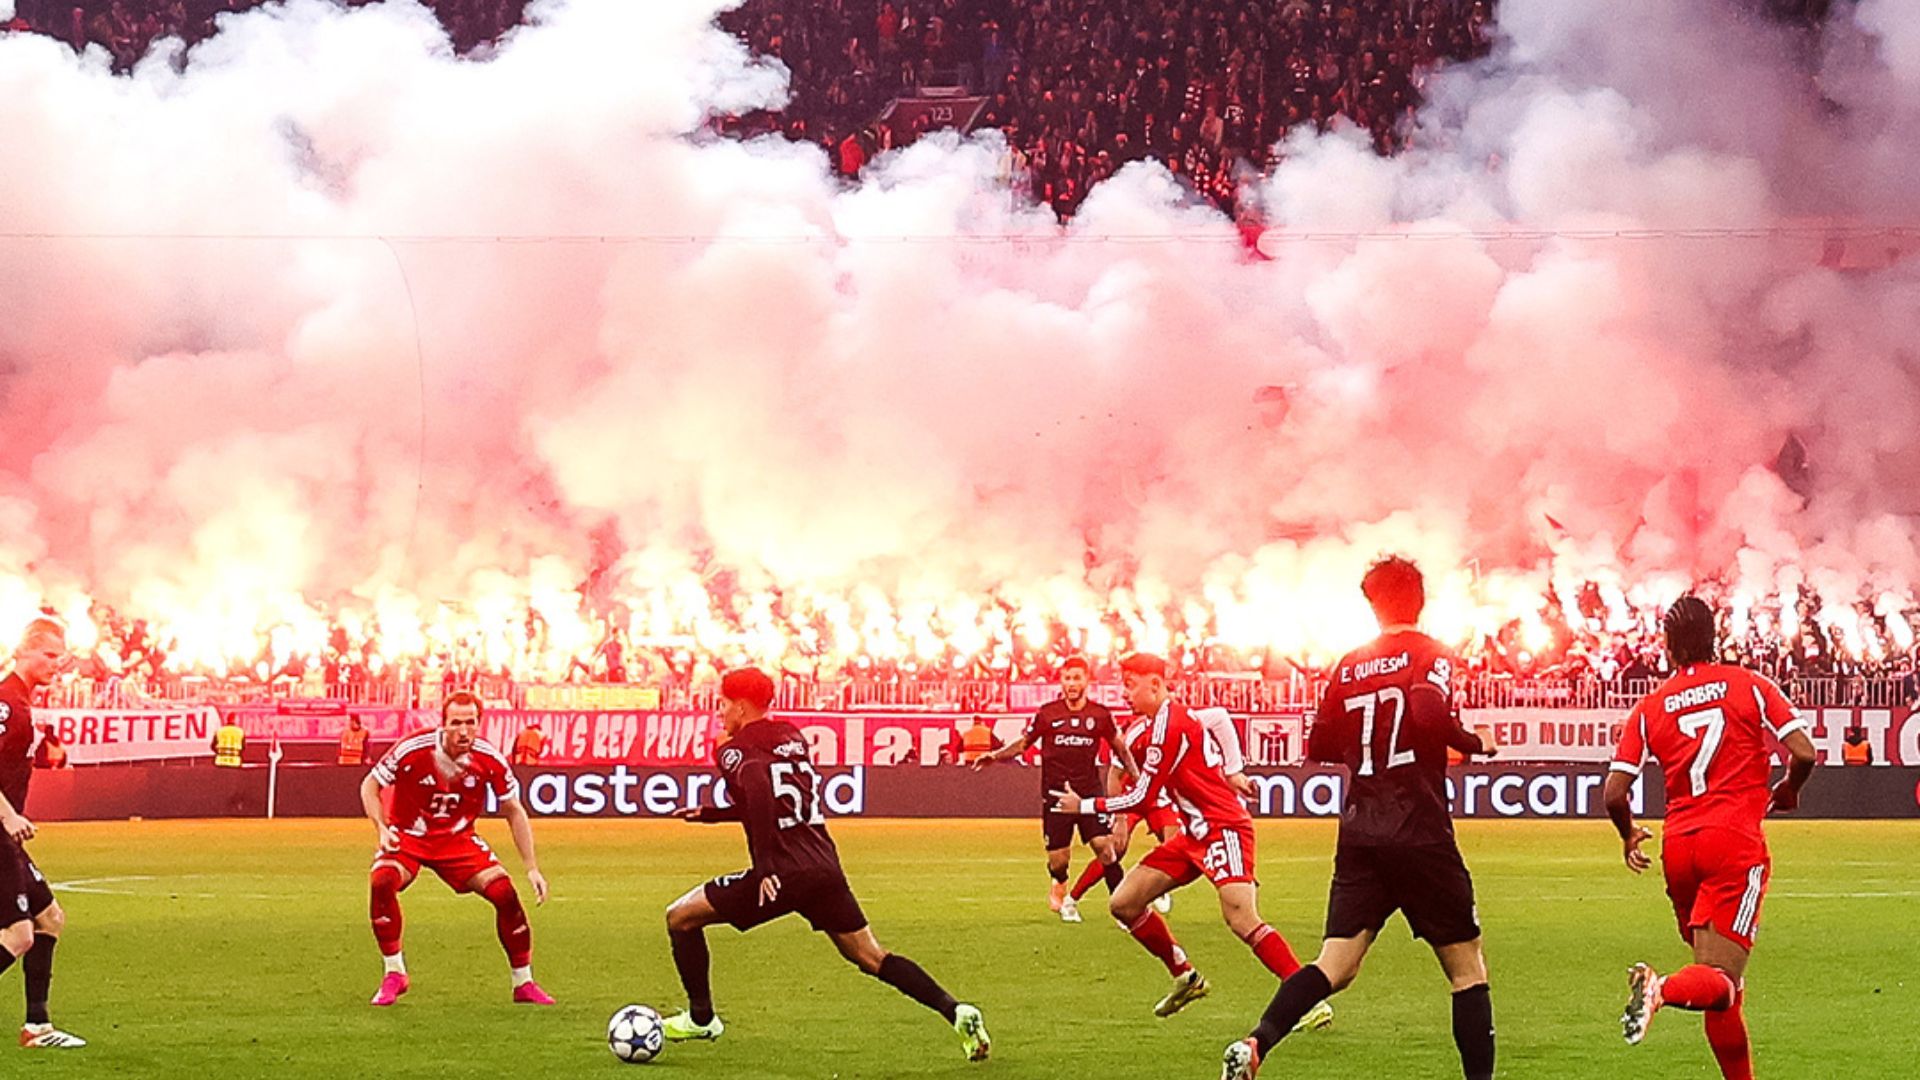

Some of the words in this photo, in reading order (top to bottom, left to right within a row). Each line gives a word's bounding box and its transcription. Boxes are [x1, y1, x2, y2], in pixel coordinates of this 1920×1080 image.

[1664, 681, 1728, 713] GNABRY
[58, 711, 207, 745] BRETTEN
[593, 713, 638, 760] RED
[643, 714, 709, 760] PRIDE
[1344, 687, 1416, 776] 72
[1473, 723, 1527, 746] ED
[1678, 708, 1725, 797] 7
